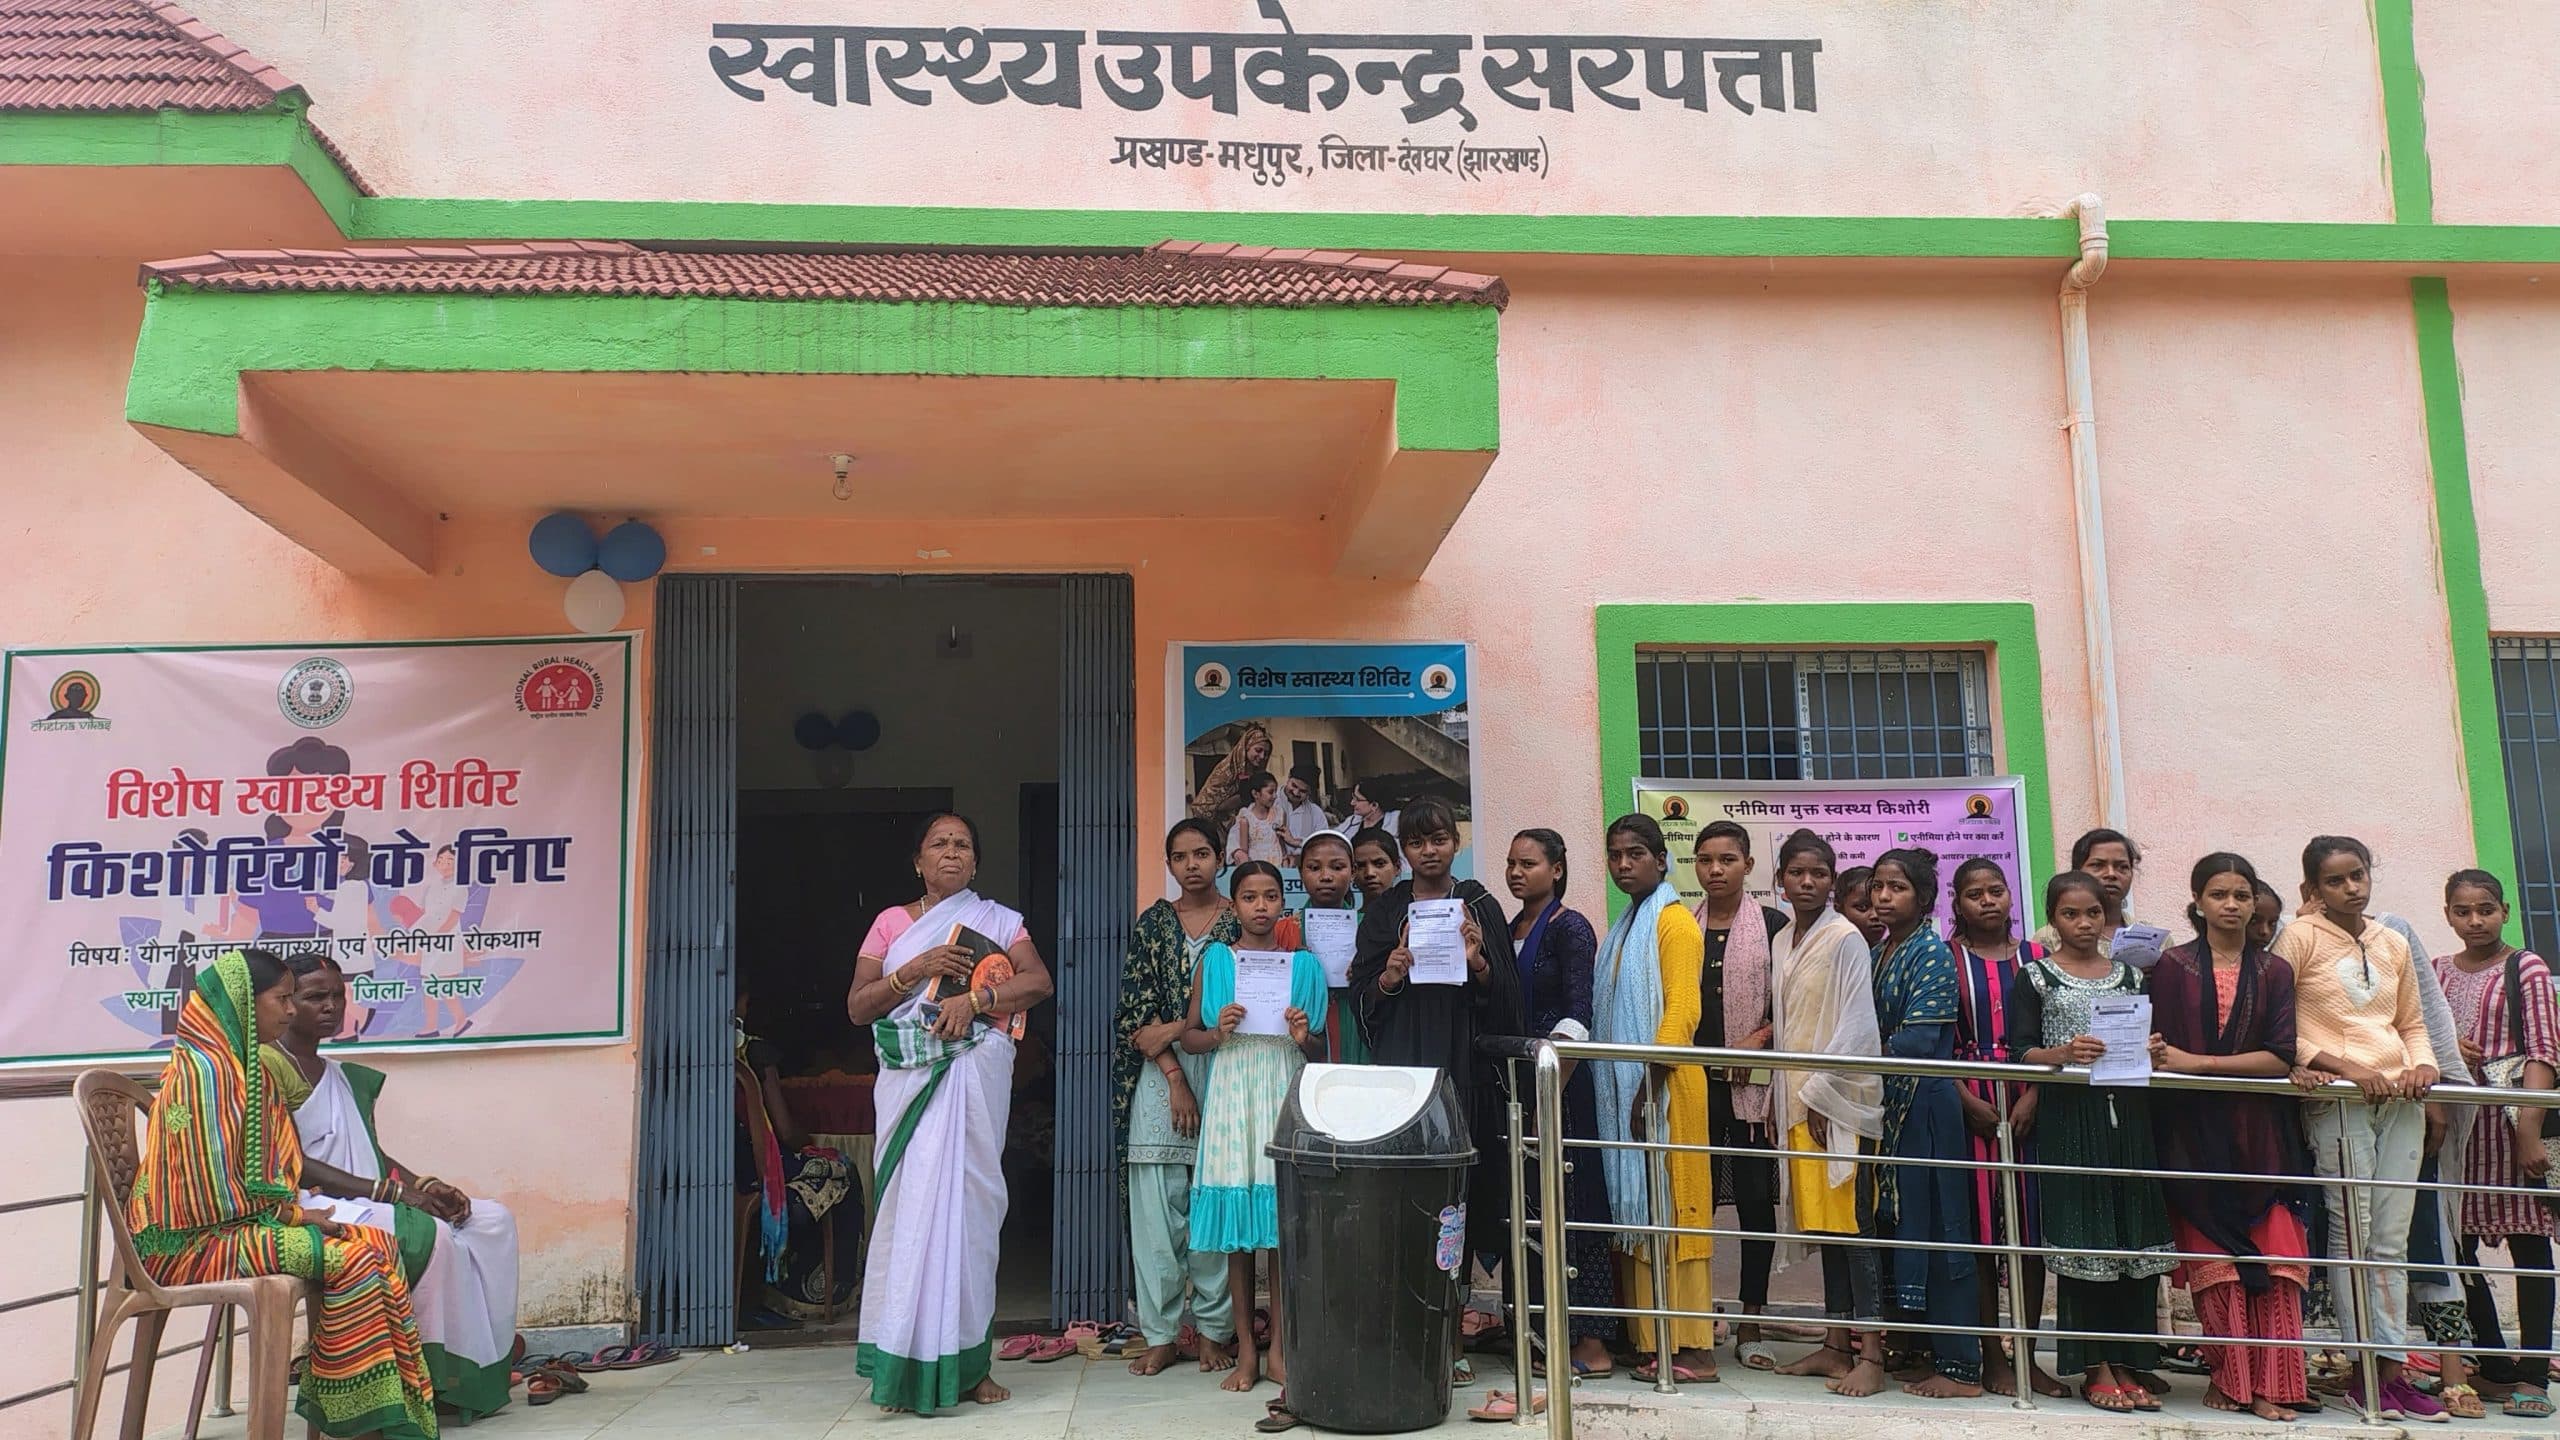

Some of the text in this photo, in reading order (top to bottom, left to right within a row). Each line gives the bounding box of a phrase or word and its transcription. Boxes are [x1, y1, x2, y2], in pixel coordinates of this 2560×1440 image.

[709, 0, 1822, 131] स्वास्थ्य उपकेन्द्र सरपत्ता
[514, 655, 604, 712] NATIONAL RURAL HEALTH MISSION
[1237, 665, 1411, 688] विशेष स्वास्थ्य शिविर
[106, 758, 522, 819] विशेष स्वास्थ्य शिविर
[1723, 800, 1785, 819] एनीमिया
[1790, 803, 1819, 819] मुक्त
[1877, 799, 1930, 816] किशोरी
[1910, 832, 1944, 842] एनीमिया
[47, 827, 573, 900] किशोरियों के लिए
[138, 938, 179, 964] यौन
[337, 933, 367, 959] एवं
[374, 929, 455, 958] एनिमिया
[464, 926, 543, 951] रोकथाम
[124, 990, 178, 1009] स्थान
[423, 973, 484, 999] देवघर
